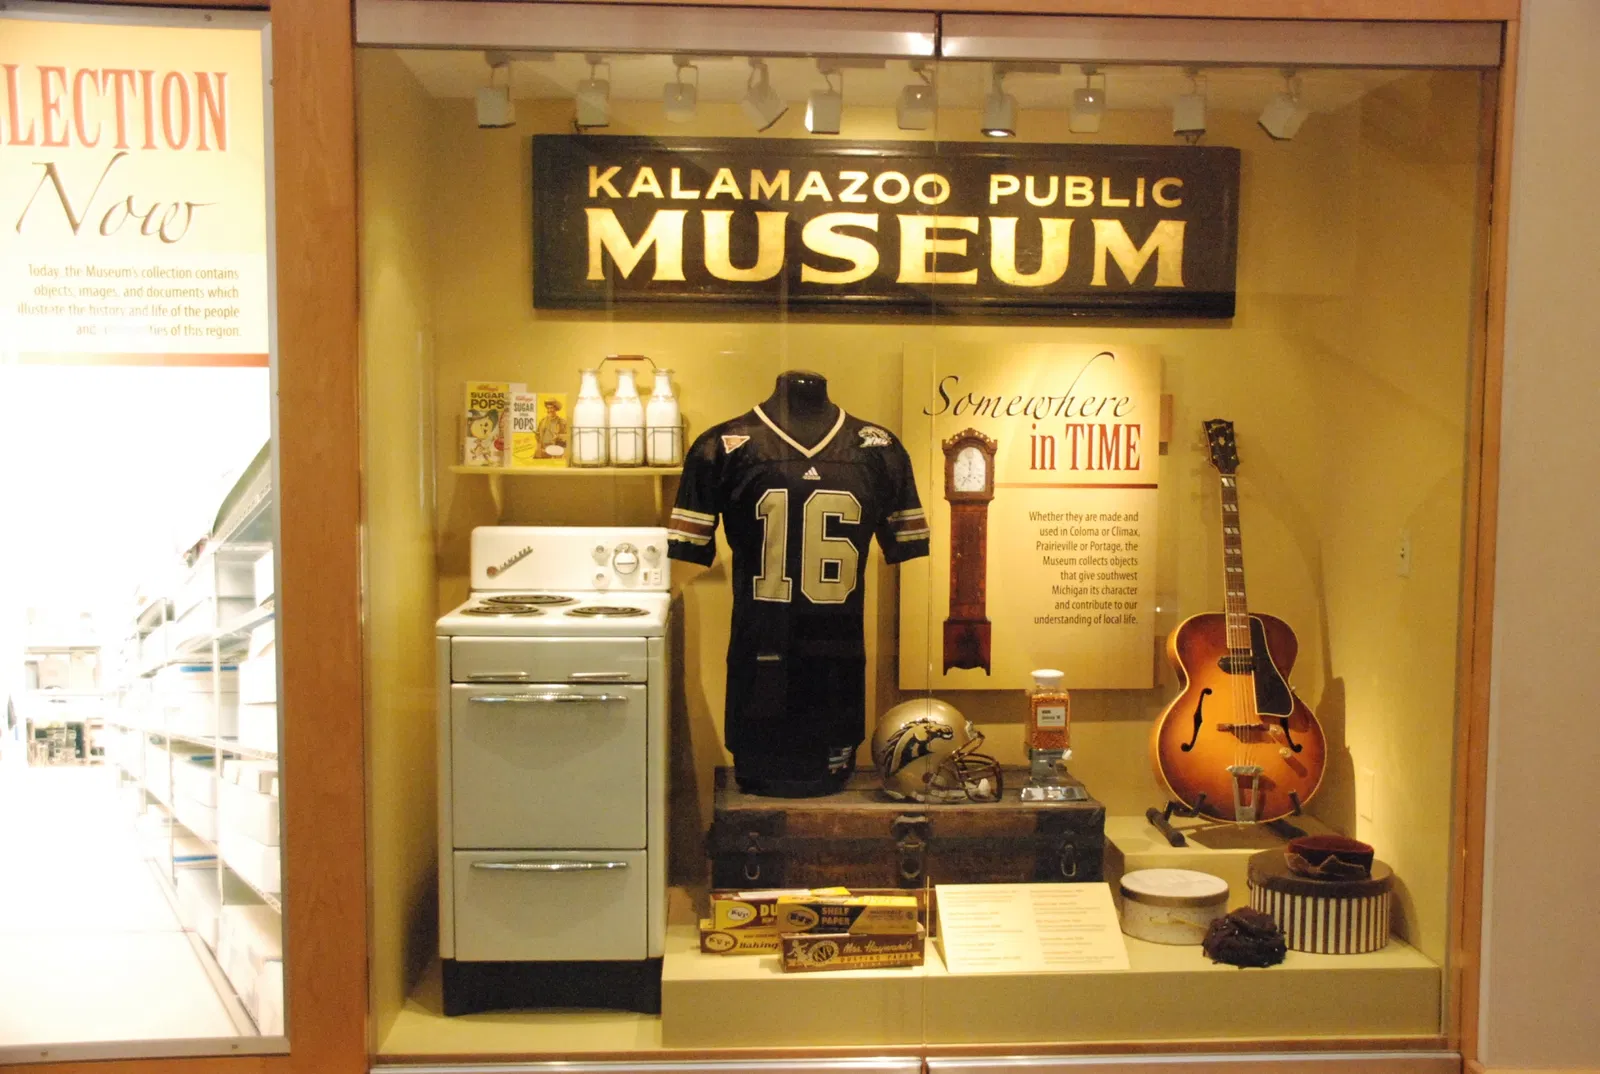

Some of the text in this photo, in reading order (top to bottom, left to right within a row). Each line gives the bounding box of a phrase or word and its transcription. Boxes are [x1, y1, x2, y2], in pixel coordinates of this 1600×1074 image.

[588, 166, 1184, 209] KALAMAZOO PUBLIC
[16, 151, 218, 244] Now
[585, 207, 1186, 289] MUSEUM
[65, 264, 82, 277] the
[86, 264, 138, 278] Museum's
[141, 265, 192, 279] collection
[195, 267, 239, 279] contains
[123, 285, 143, 298] and
[147, 286, 204, 299] documents
[208, 285, 239, 298] which
[17, 301, 240, 320] illustrate the history and life of the people
[171, 324, 182, 337] of
[184, 324, 203, 337] this
[206, 327, 242, 340] region.
[923, 351, 1134, 420] Somewhere
[471, 399, 504, 409] POPS
[513, 403, 534, 412] SUGAR
[513, 418, 534, 431] POPS
[1029, 423, 1141, 472] in TIME
[1028, 511, 1139, 524] Whether they are made and
[1039, 526, 1140, 537] used in Coloma or Climax,
[753, 488, 862, 604] 16
[1036, 540, 1138, 553] Prairieville or Portage, the
[1042, 556, 1138, 568] Museum collects objects
[1060, 571, 1138, 582] that give southwest
[1051, 585, 1138, 597] Michigan its character
[1054, 600, 1138, 610] and contribute to our
[1034, 614, 1139, 627] understanding of local life.
[822, 906, 850, 915] SHELF
[822, 916, 850, 925] PAPER
